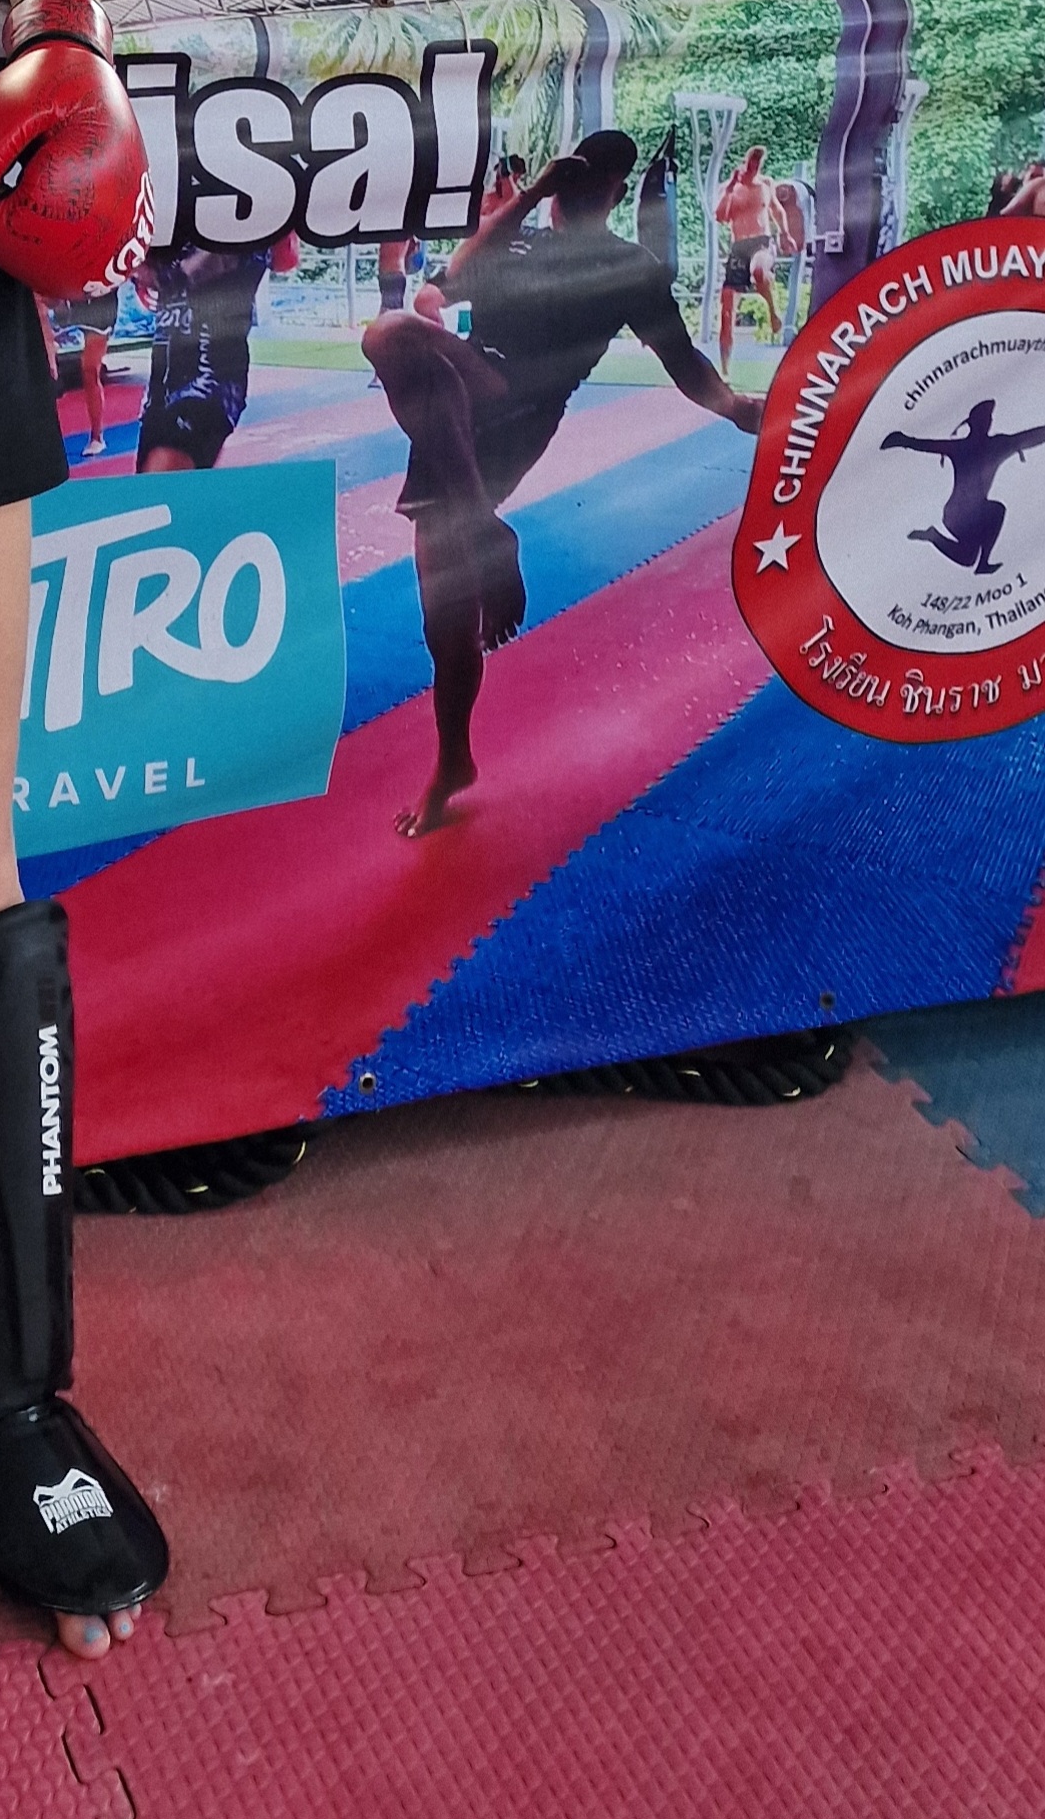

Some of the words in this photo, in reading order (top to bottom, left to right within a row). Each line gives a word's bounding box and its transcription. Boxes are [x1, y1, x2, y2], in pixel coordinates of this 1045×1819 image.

[773, 264, 934, 504] CHINNARACH
[887, 603, 913, 631] Koh
[912, 617, 982, 640] Phangan,
[985, 588, 1045, 630] Thailan
[920, 592, 972, 615] 148/22
[974, 582, 1013, 608] Moo
[12, 756, 206, 812] RAVEL
[38, 1024, 64, 1196] PHANTOM
